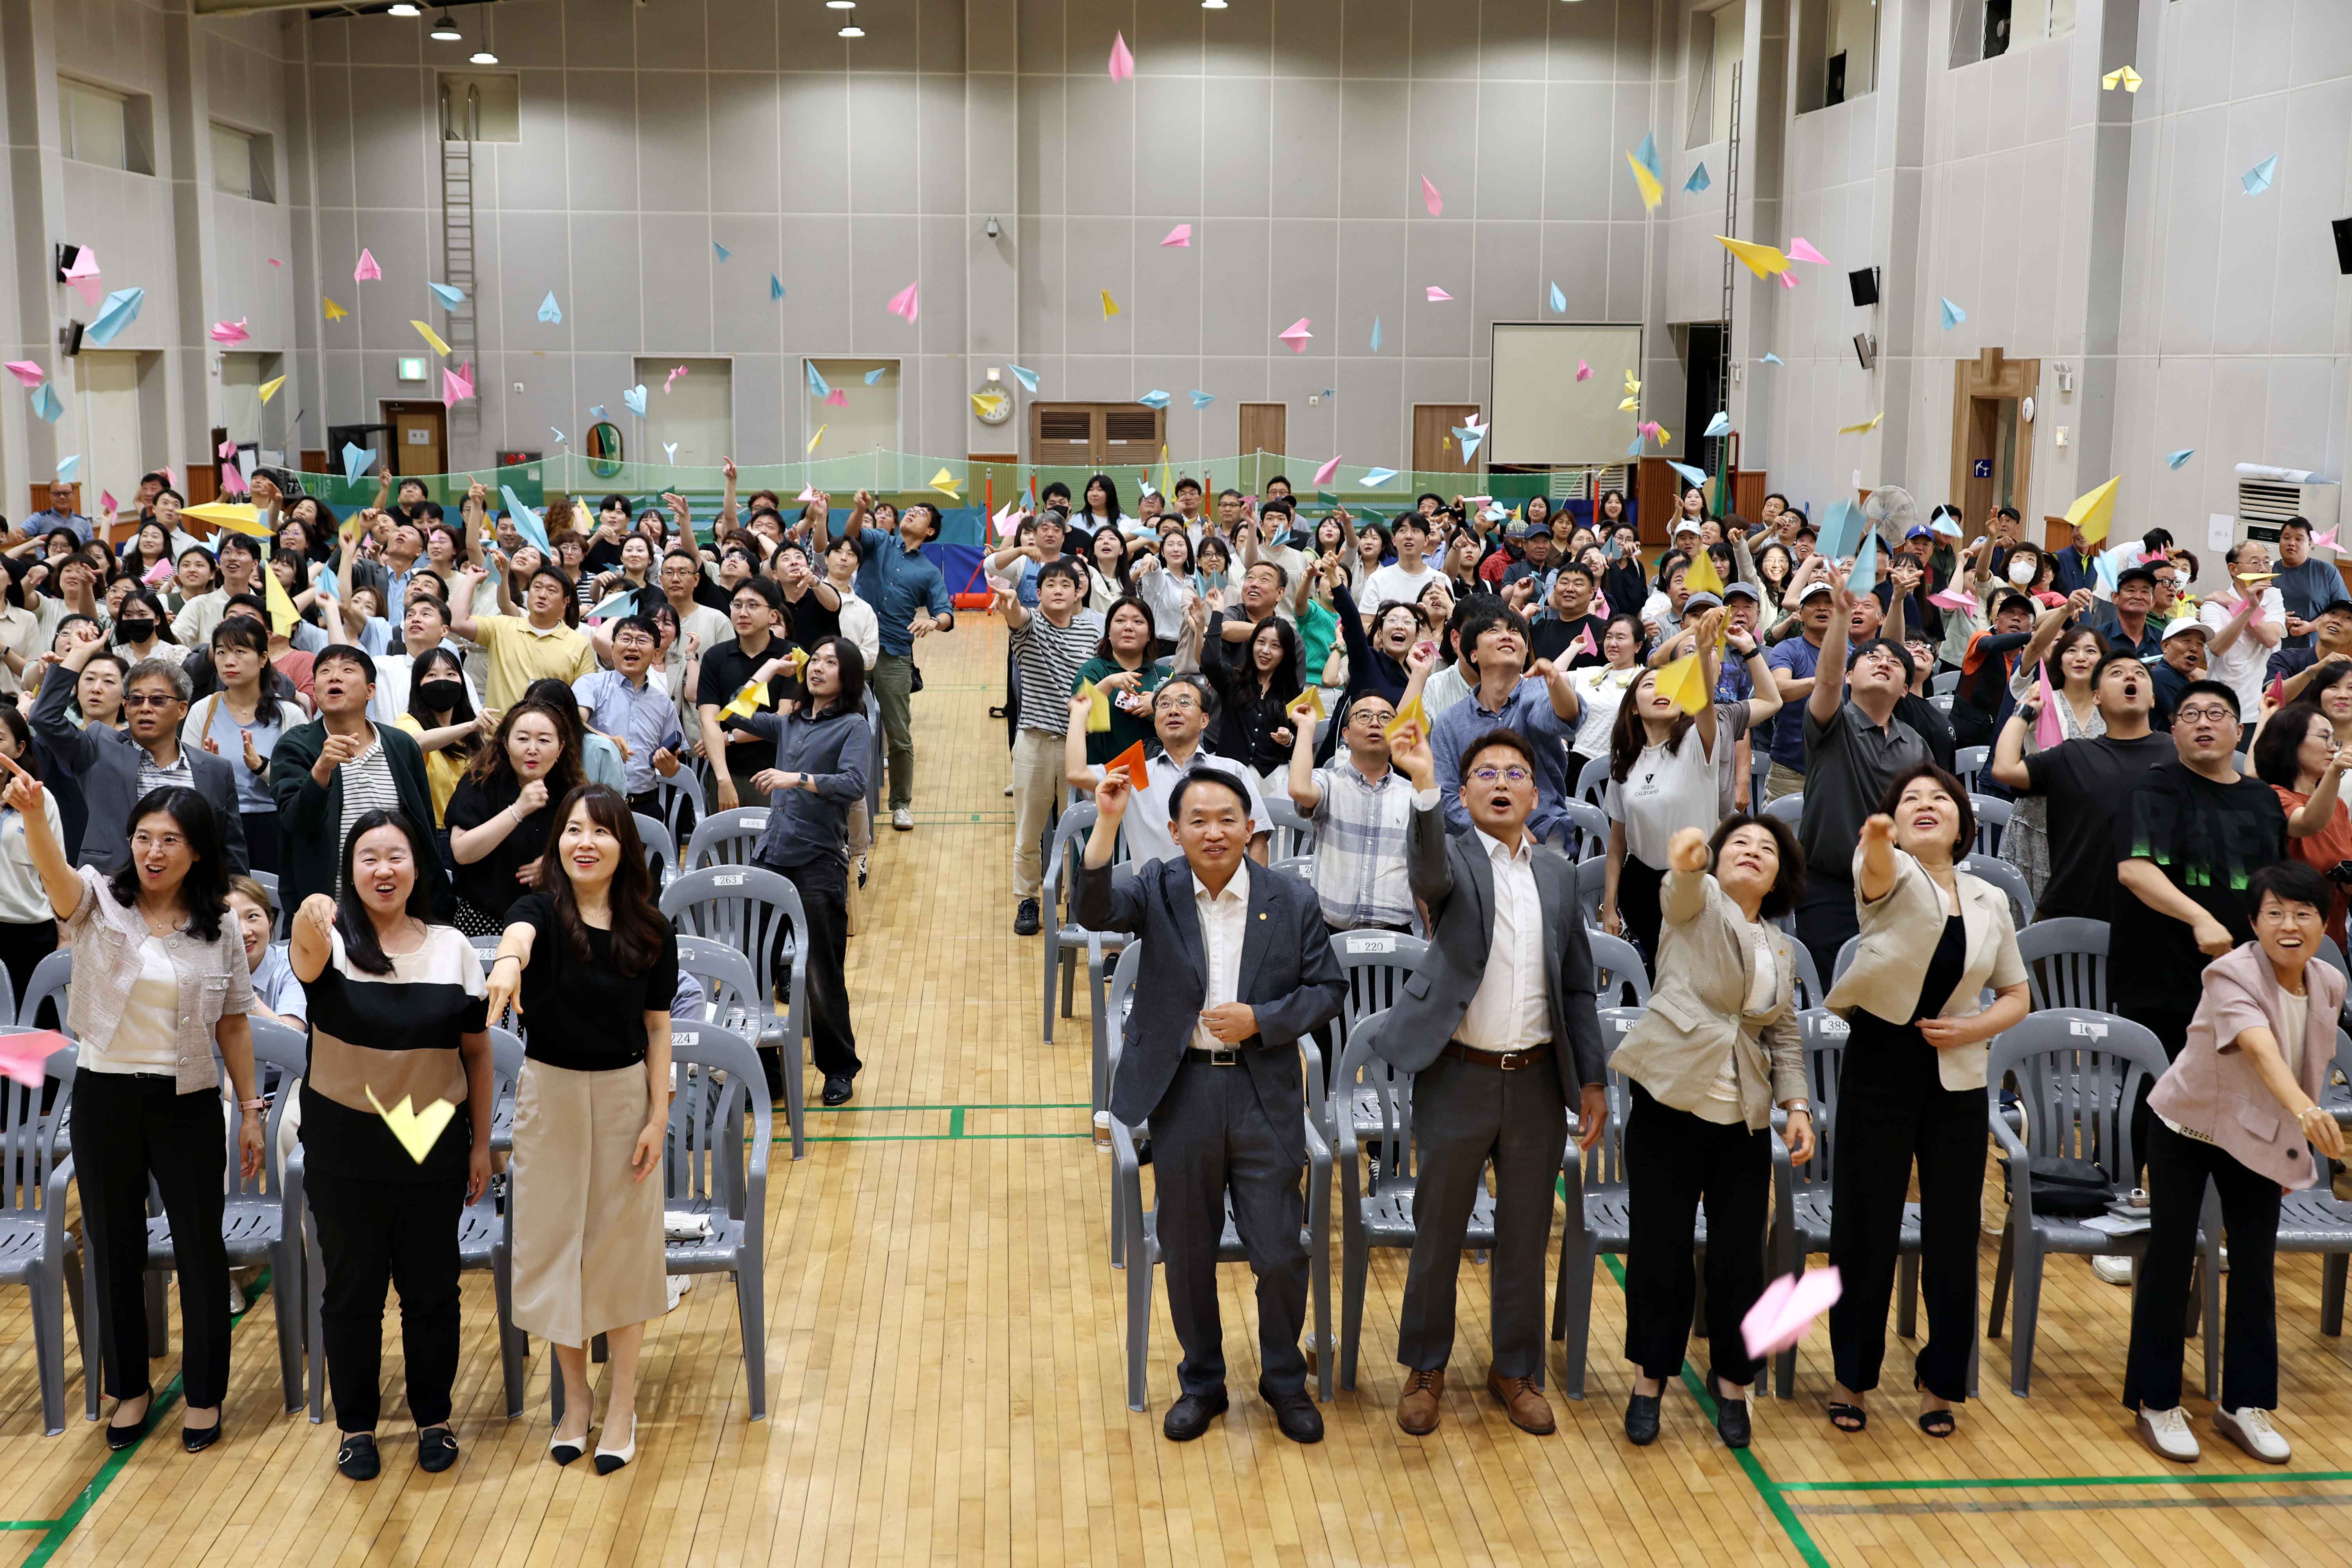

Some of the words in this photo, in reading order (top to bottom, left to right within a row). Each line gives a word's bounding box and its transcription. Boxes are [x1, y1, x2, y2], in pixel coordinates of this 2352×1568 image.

[720, 875, 737, 884] 263
[1365, 942, 1383, 951] 220
[1828, 1020, 1848, 1031] 385
[671, 1033, 690, 1044] 224
